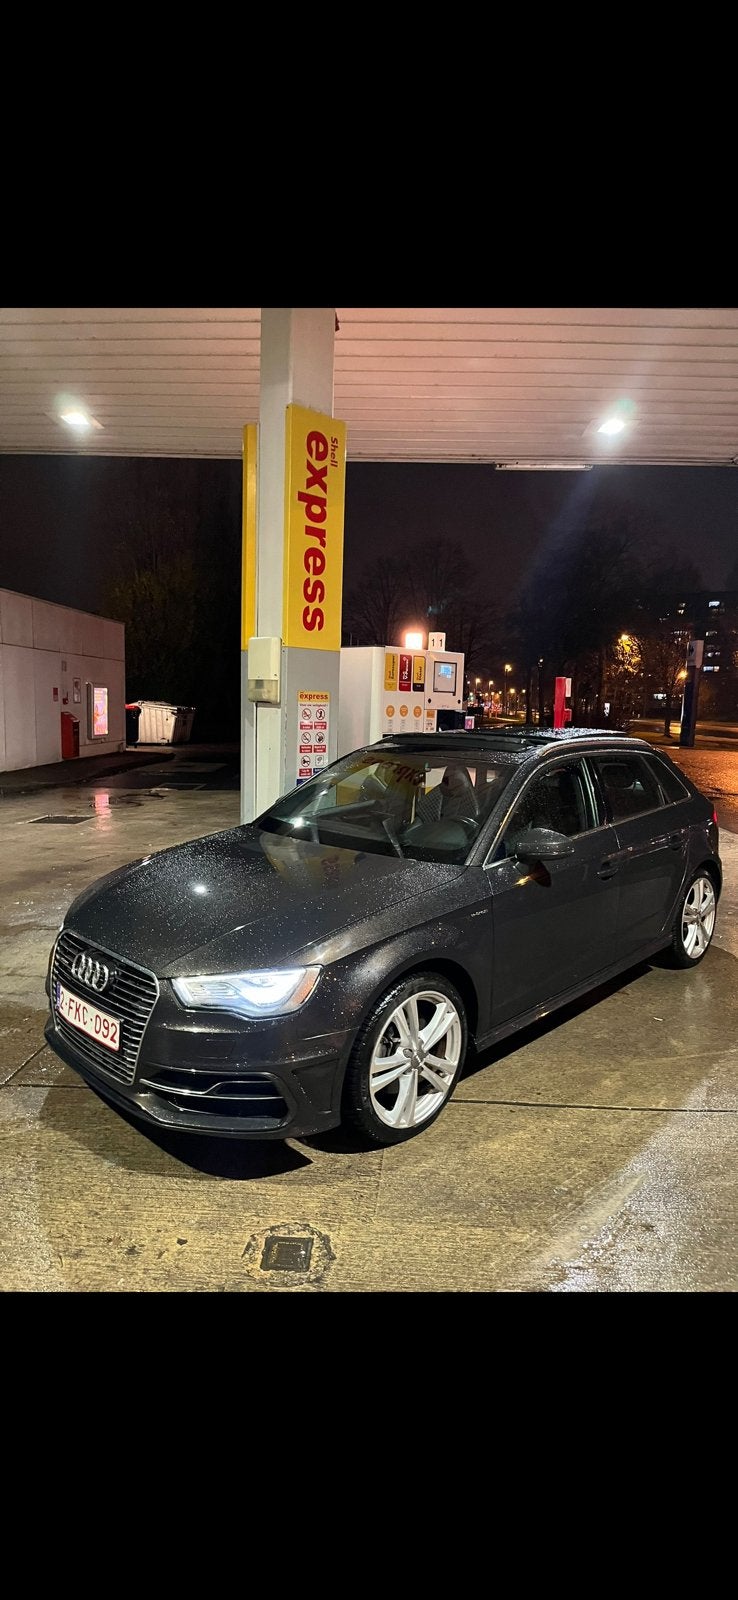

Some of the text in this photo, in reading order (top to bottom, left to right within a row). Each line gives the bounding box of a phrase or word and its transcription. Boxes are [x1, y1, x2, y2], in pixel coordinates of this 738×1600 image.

[330, 436, 339, 468] Shell
[297, 430, 329, 632] express
[299, 693, 329, 701] express
